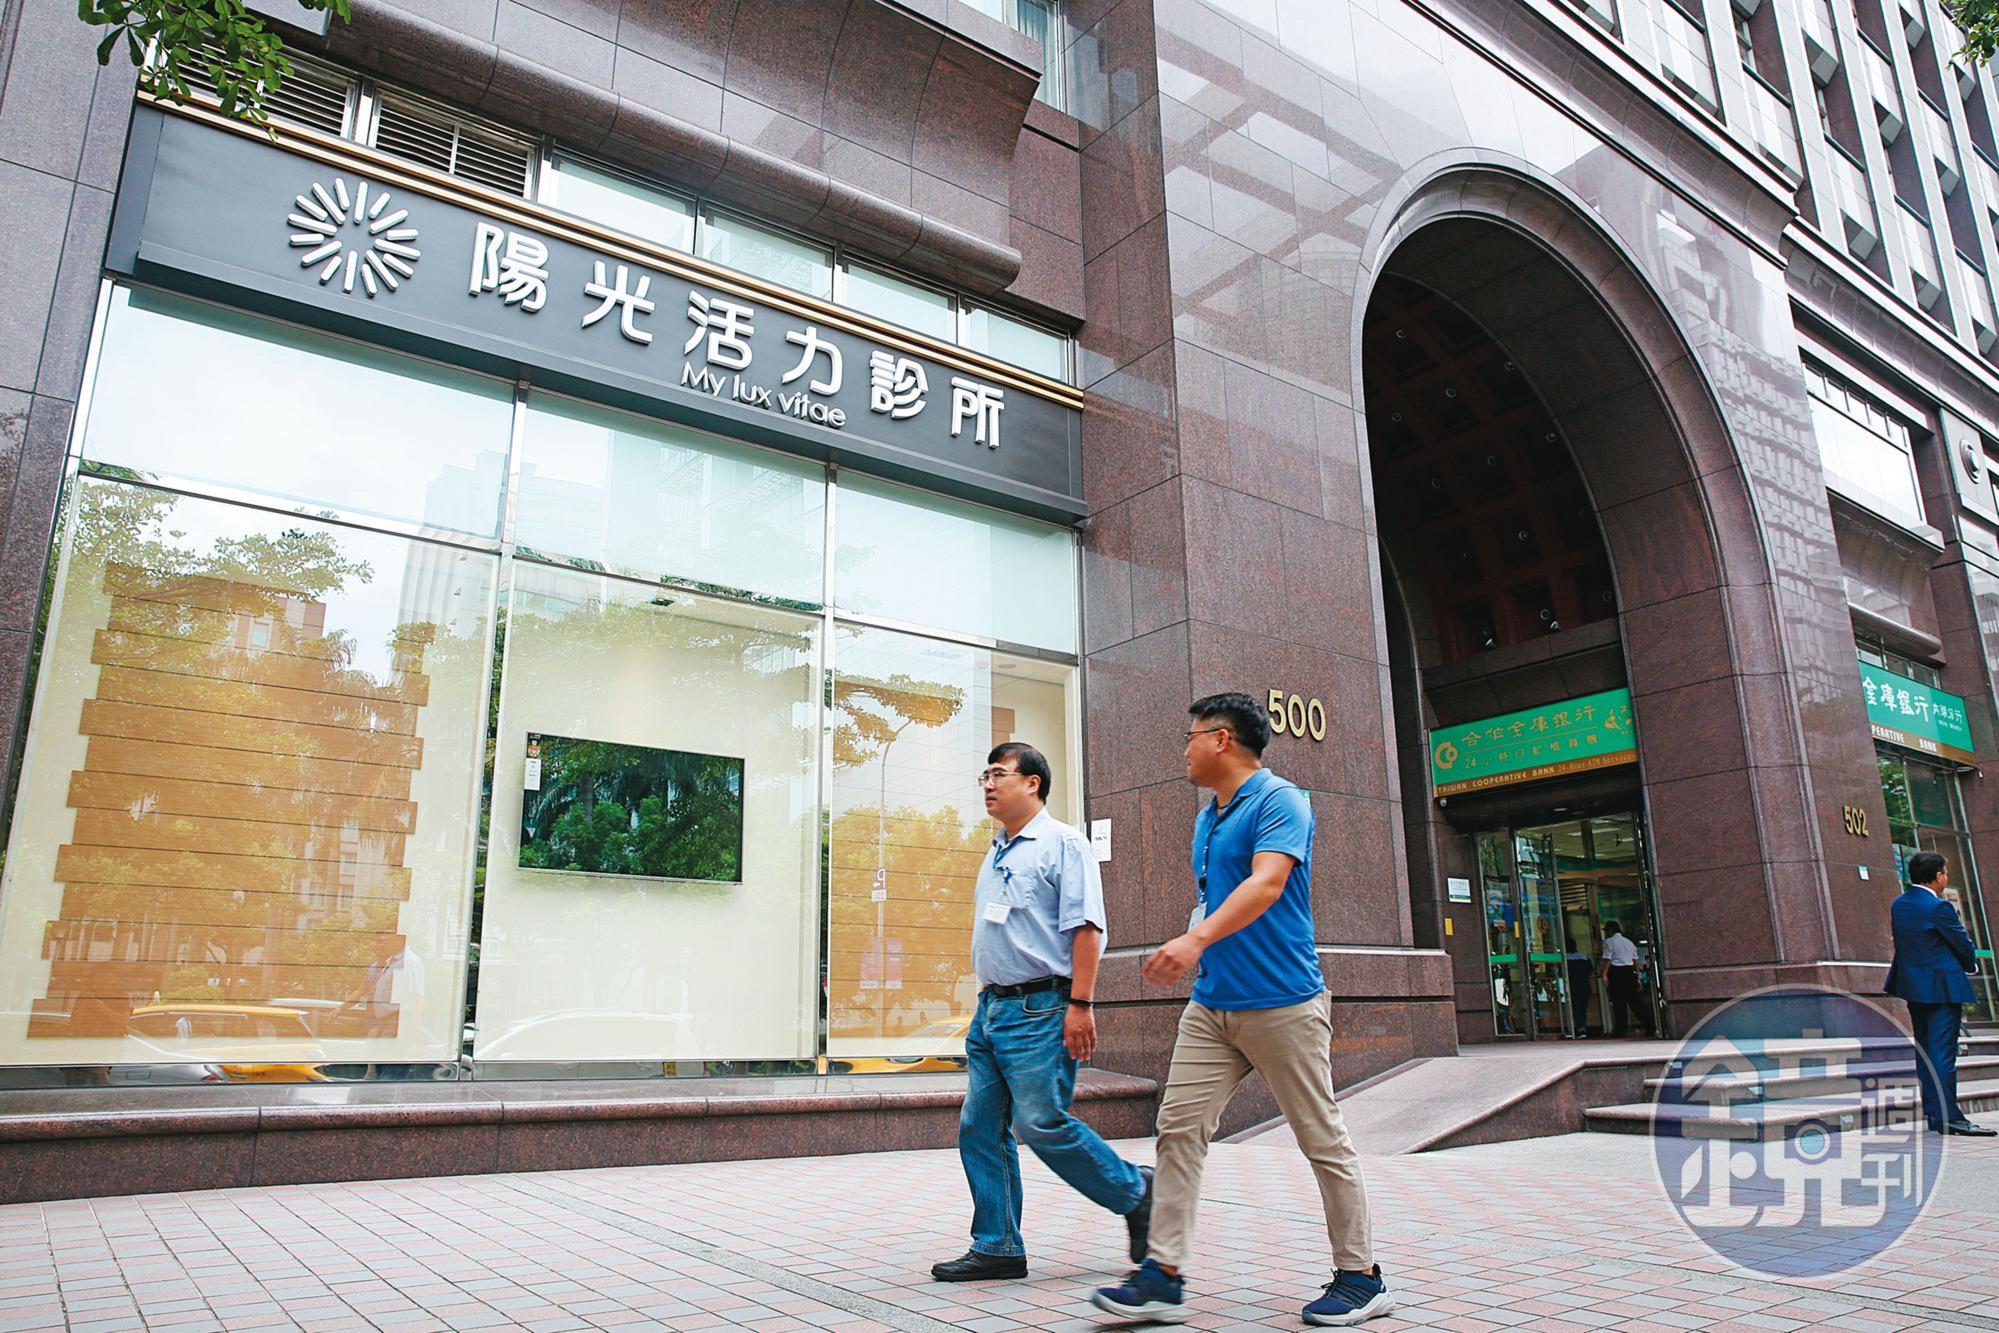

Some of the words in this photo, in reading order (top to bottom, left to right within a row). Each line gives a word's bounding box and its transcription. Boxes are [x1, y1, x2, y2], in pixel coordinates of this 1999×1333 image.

[469, 221, 1006, 449] 陽光活力診所
[681, 361, 727, 397] My
[732, 374, 773, 410] lux
[777, 391, 847, 429] vitae
[1268, 688, 1327, 742] 500
[1461, 705, 1596, 747] 合作金庫銀行
[1438, 783, 1467, 794] TAIWAN
[1472, 771, 1527, 788] COOPERATIVE
[1532, 766, 1555, 777] BANK
[1843, 805, 1870, 837] 502
